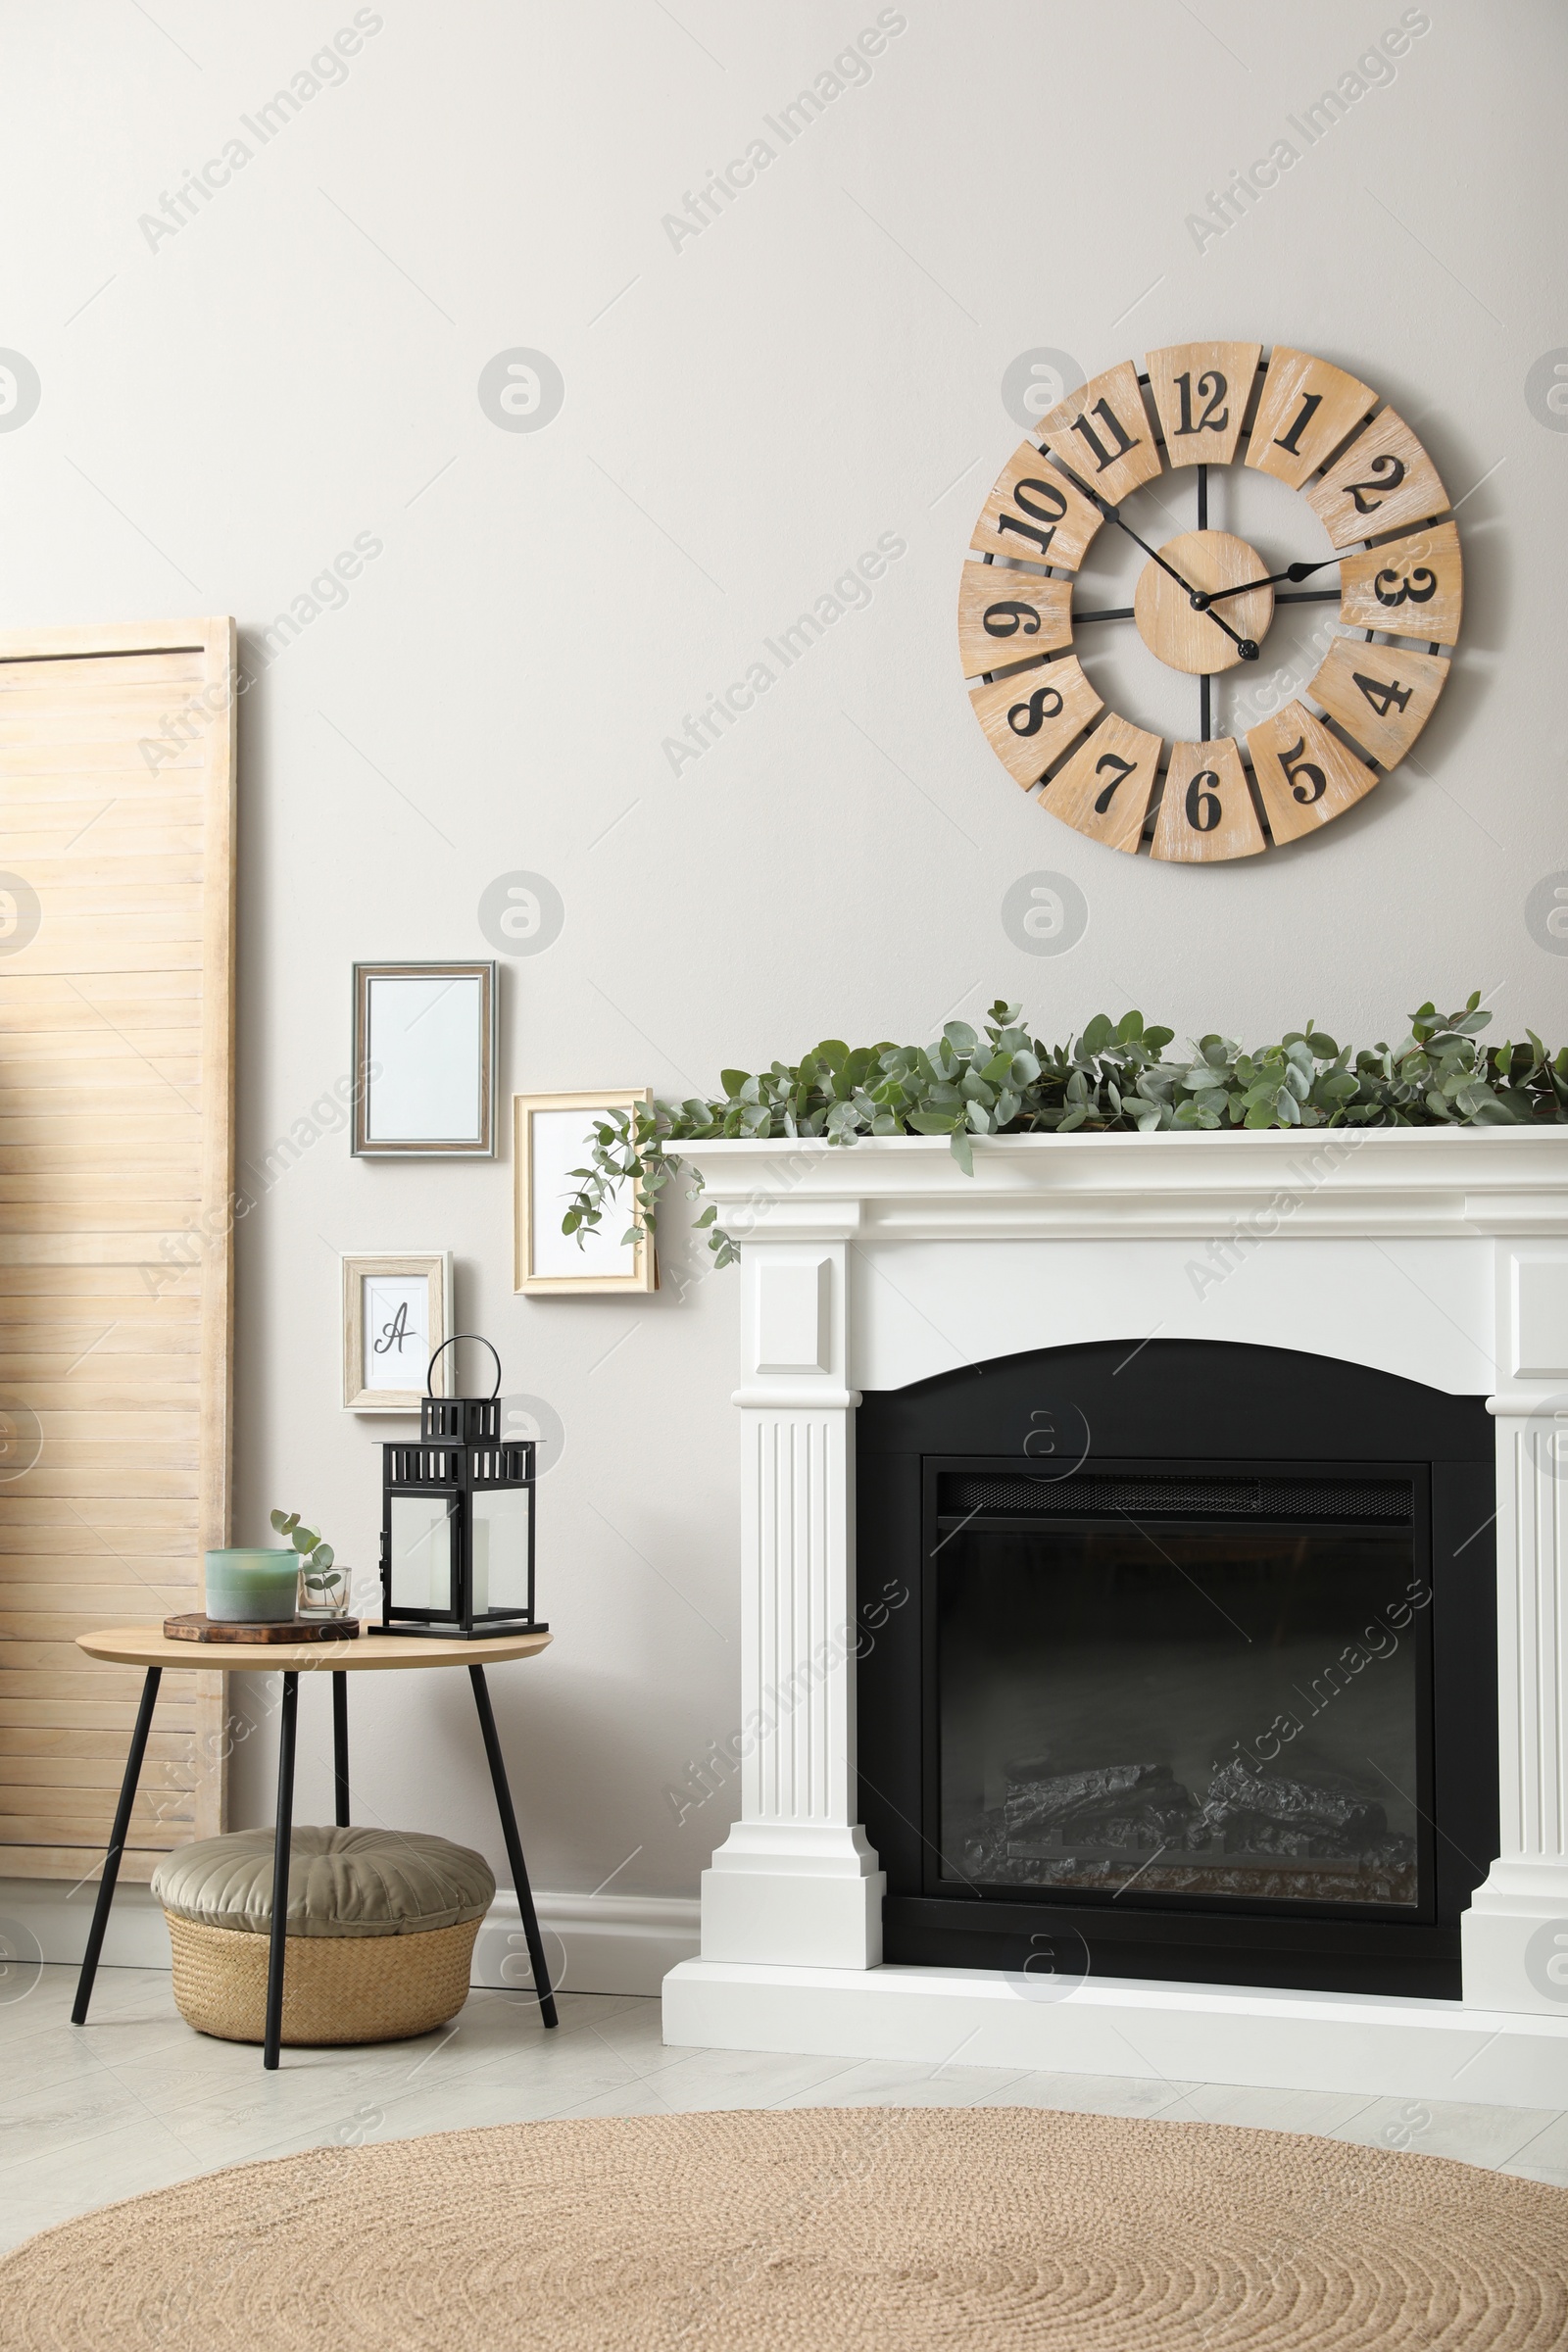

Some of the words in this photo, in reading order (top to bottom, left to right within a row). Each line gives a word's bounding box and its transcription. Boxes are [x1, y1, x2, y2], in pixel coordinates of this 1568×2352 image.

[1173, 370, 1229, 436] 12
[1273, 392, 1323, 457] 1
[1070, 397, 1141, 473] 11
[1342, 454, 1406, 514] 2
[997, 478, 1068, 556] 10
[1374, 567, 1438, 608] 3
[983, 601, 1042, 638] 9
[1007, 687, 1063, 737] 8
[1351, 671, 1413, 717] 4
[1094, 753, 1138, 814] 7
[1185, 770, 1222, 832] 6
[1277, 735, 1327, 806] 5
[373, 1301, 417, 1354] A
